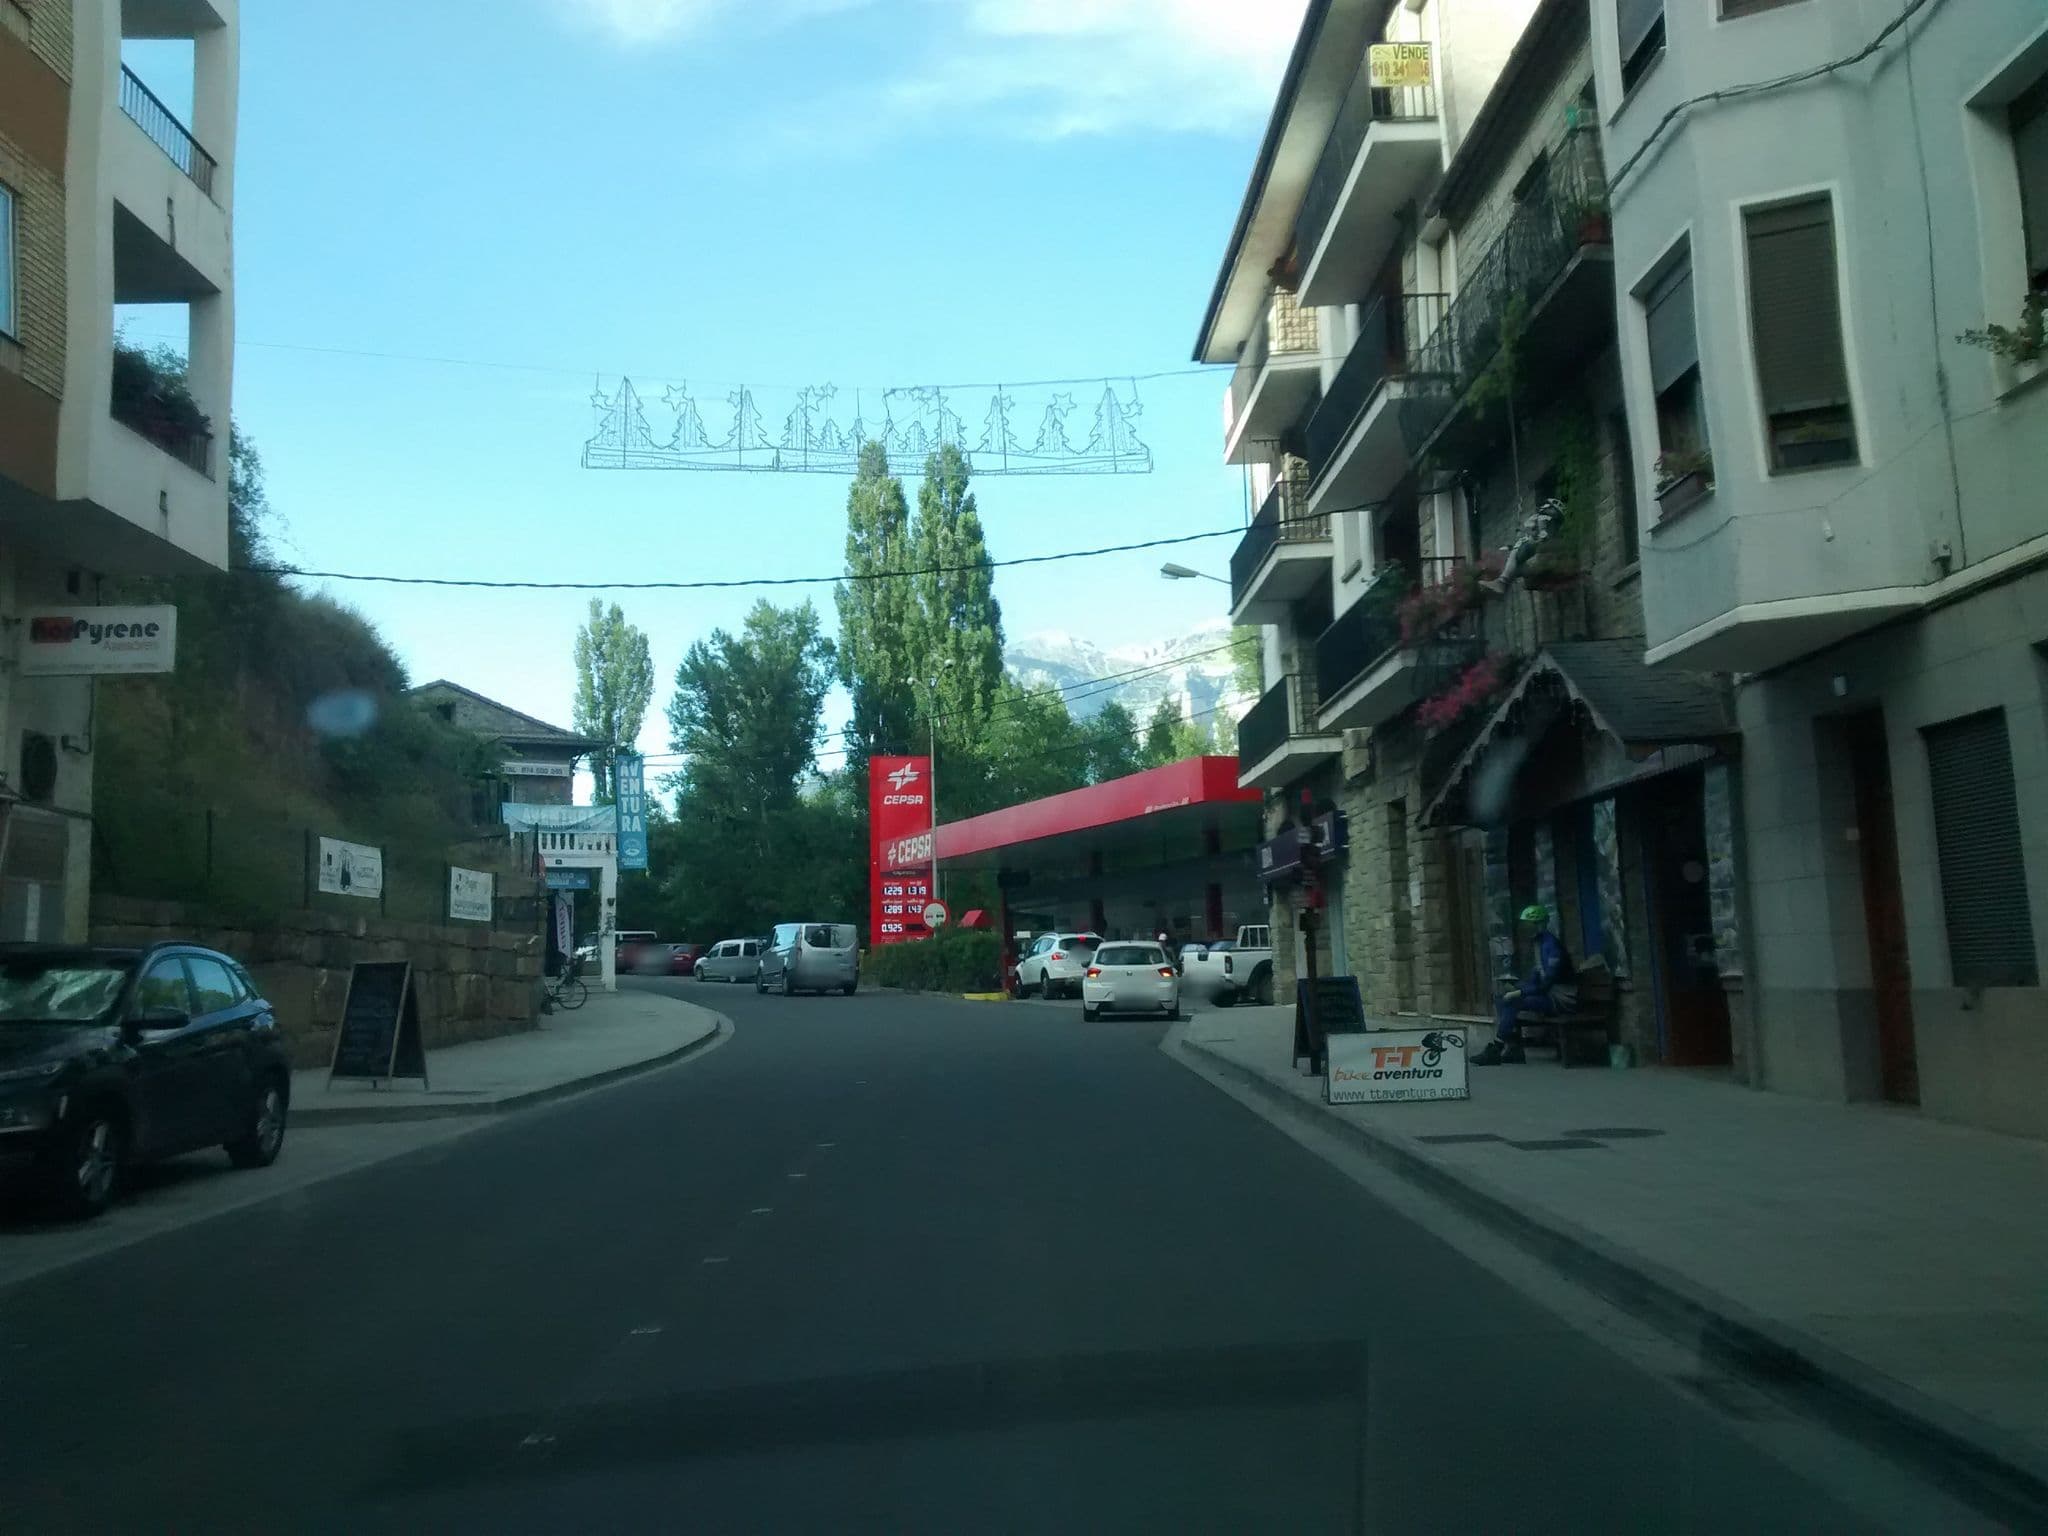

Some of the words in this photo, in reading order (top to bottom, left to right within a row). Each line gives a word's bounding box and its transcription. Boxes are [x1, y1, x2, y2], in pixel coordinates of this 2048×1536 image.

[1393, 46, 1429, 60] VENDE
[883, 795, 924, 805] CEPSA
[898, 833, 932, 864] CEPSA
[1373, 1068, 1443, 1080] aventura
